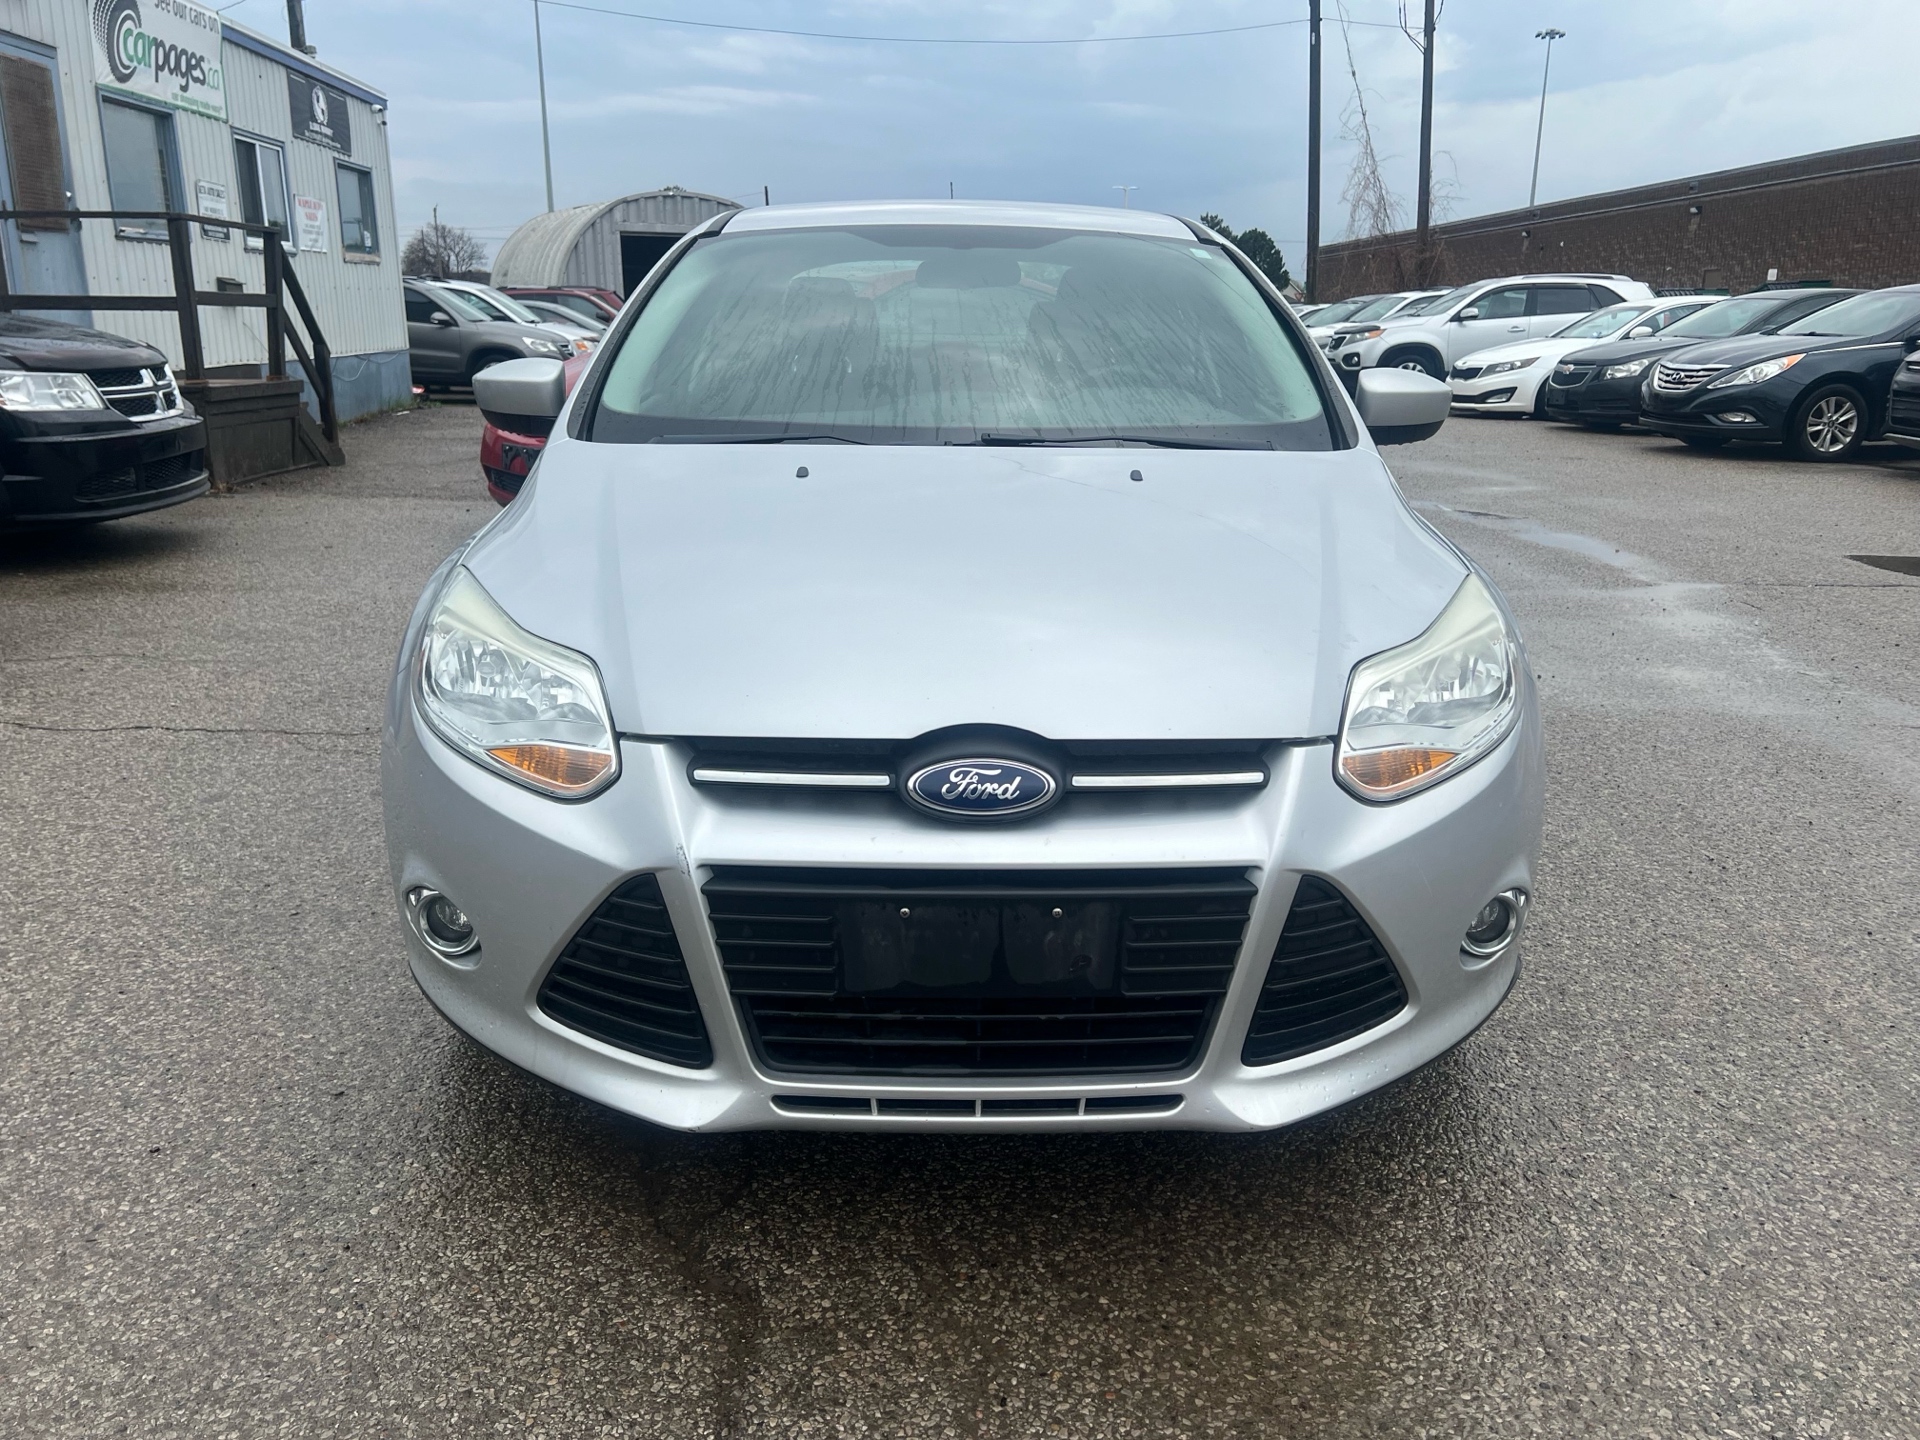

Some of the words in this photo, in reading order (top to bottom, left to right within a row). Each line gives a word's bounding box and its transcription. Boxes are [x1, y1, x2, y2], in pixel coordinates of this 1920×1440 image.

[173, 0, 187, 20] our
[189, 7, 207, 29] cars
[208, 15, 220, 34] on
[941, 767, 1022, 800] Ford
